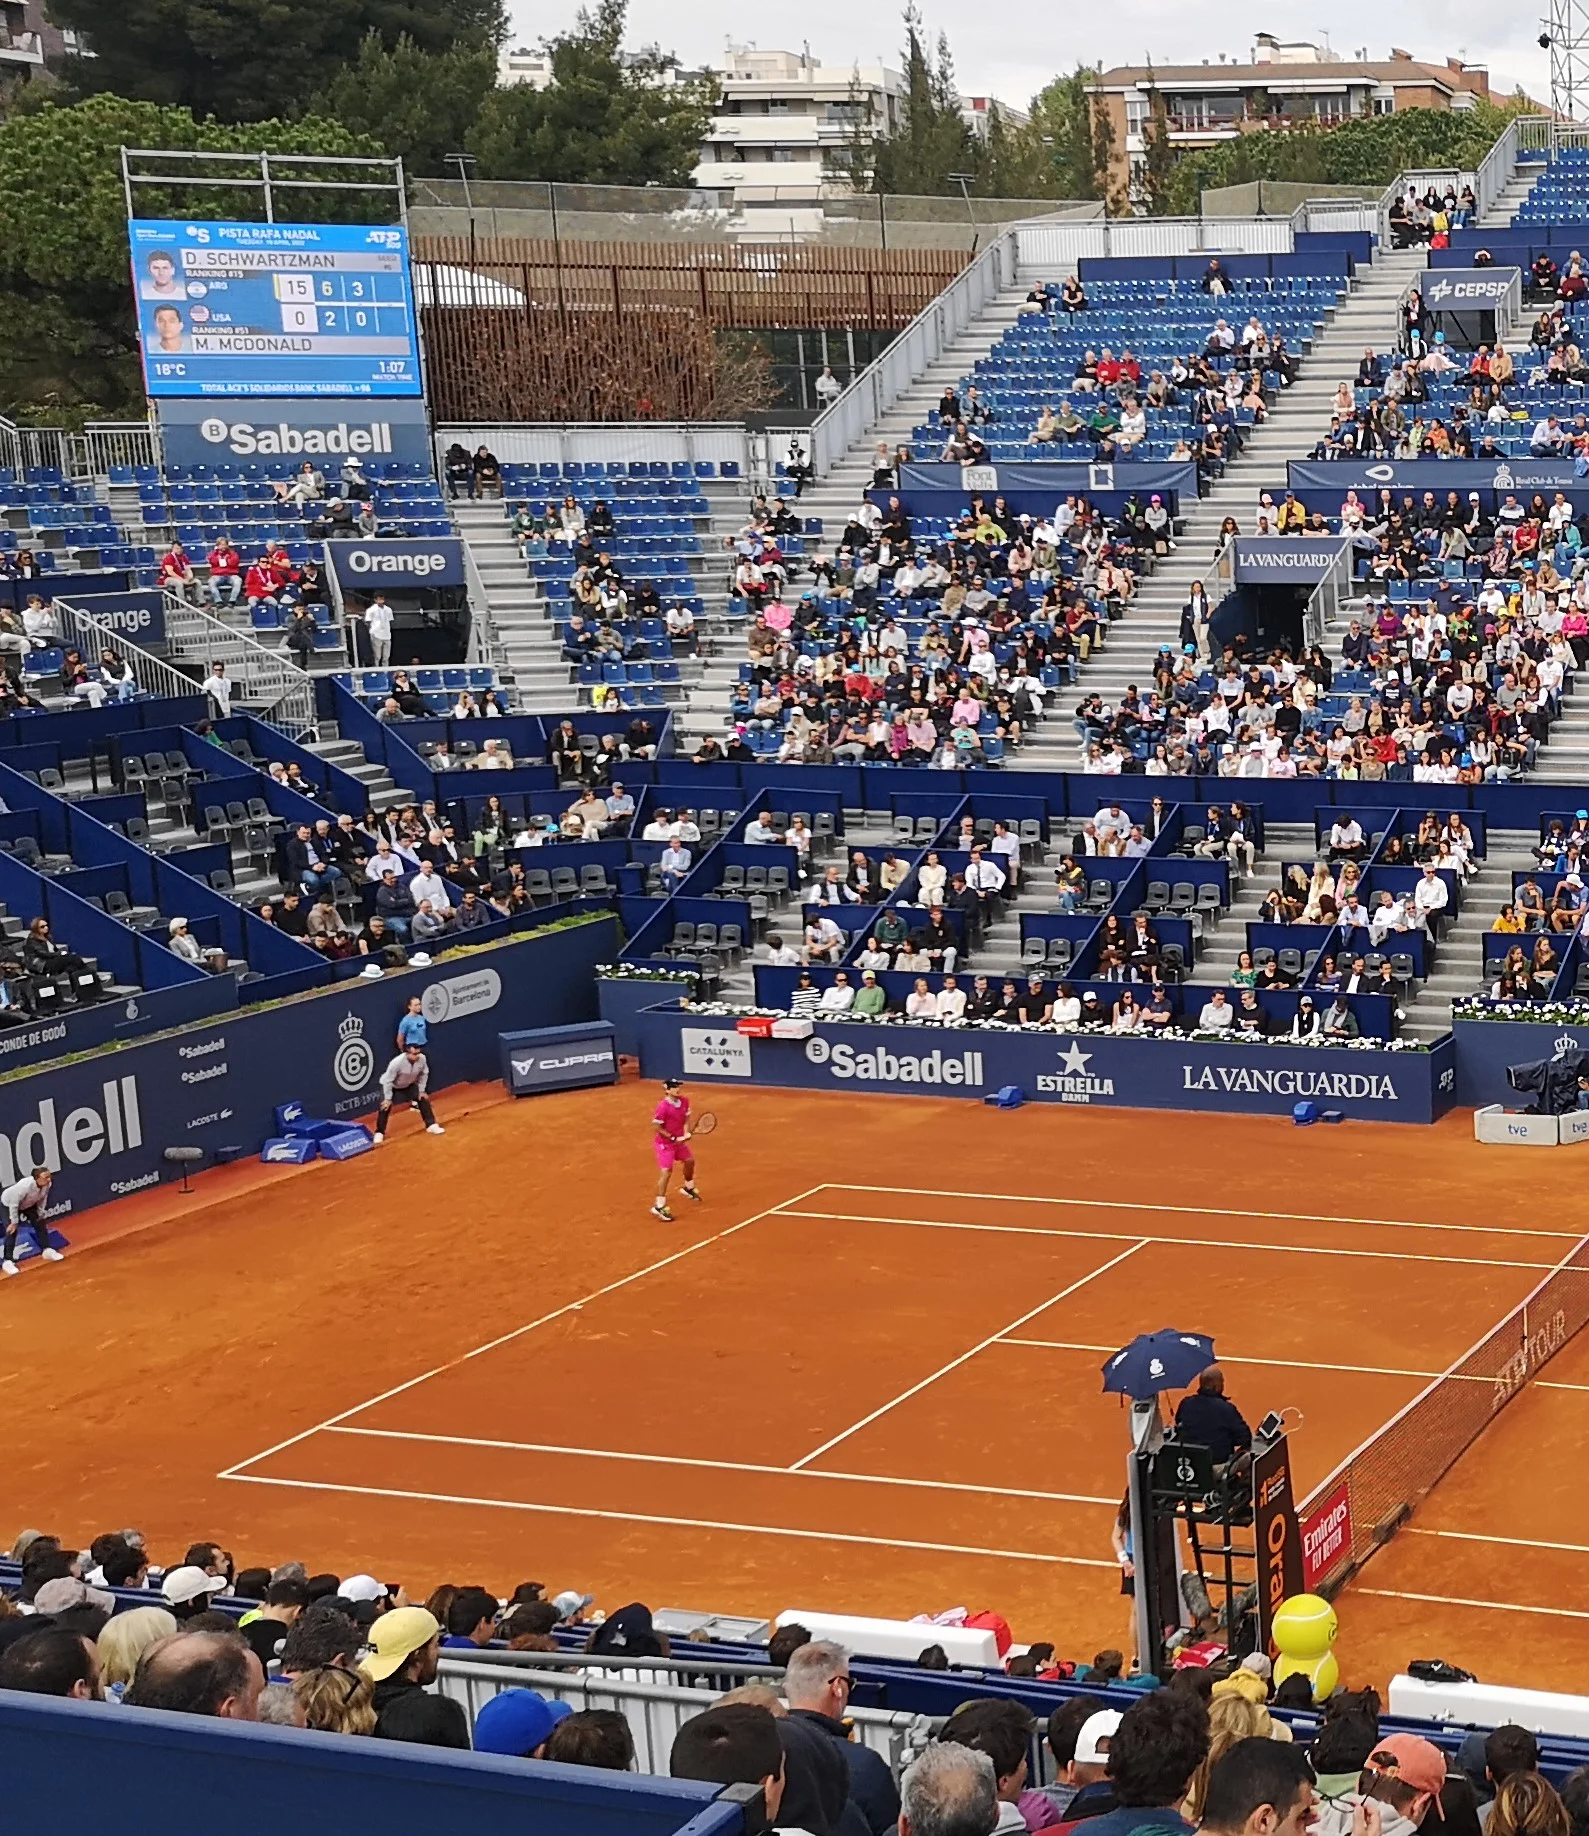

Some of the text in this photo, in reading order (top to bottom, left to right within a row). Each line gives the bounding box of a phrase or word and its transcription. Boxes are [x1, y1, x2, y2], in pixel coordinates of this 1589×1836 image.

[219, 228, 321, 241] PISTA RAFA NADAL
[185, 252, 335, 268] D. SCHWARTZMAN
[185, 269, 227, 278] RANKING
[287, 280, 364, 297] 15 6 3
[1454, 282, 1509, 298] CEPSA
[295, 311, 367, 327] 0 2 0
[191, 326, 234, 335] RANKING
[195, 338, 313, 351] M. MCDONALD
[155, 363, 186, 376] 18°C
[379, 361, 406, 373] 1:07
[229, 422, 392, 454] Sabadell
[966, 470, 992, 481] Font
[348, 550, 446, 576] Orange
[1239, 553, 1342, 567] LA VANGUARDIA
[75, 605, 151, 632] Orange
[452, 989, 491, 1006] Barcelona
[29, 1031, 41, 1046] DE
[42, 1021, 67, 1042] GODÓ
[187, 1038, 226, 1058] Sabadell
[689, 1047, 745, 1057] CATALUNYA
[539, 1051, 614, 1070] CUPRA
[830, 1044, 983, 1085] Sabadell
[188, 1062, 228, 1084] Sabadell
[1037, 1075, 1115, 1095] ESTRELLA
[1183, 1066, 1398, 1100] LA VANGUARDIA
[1062, 1093, 1090, 1103] DAMM
[187, 1112, 218, 1129] LACOSTE
[1572, 1122, 1588, 1134] tve
[0, 1075, 142, 1189] dell
[1508, 1123, 1528, 1137] tve
[119, 1171, 159, 1194] Sabadell
[1528, 1309, 1566, 1367] TOUR
[1304, 1500, 1347, 1557] Emirates
